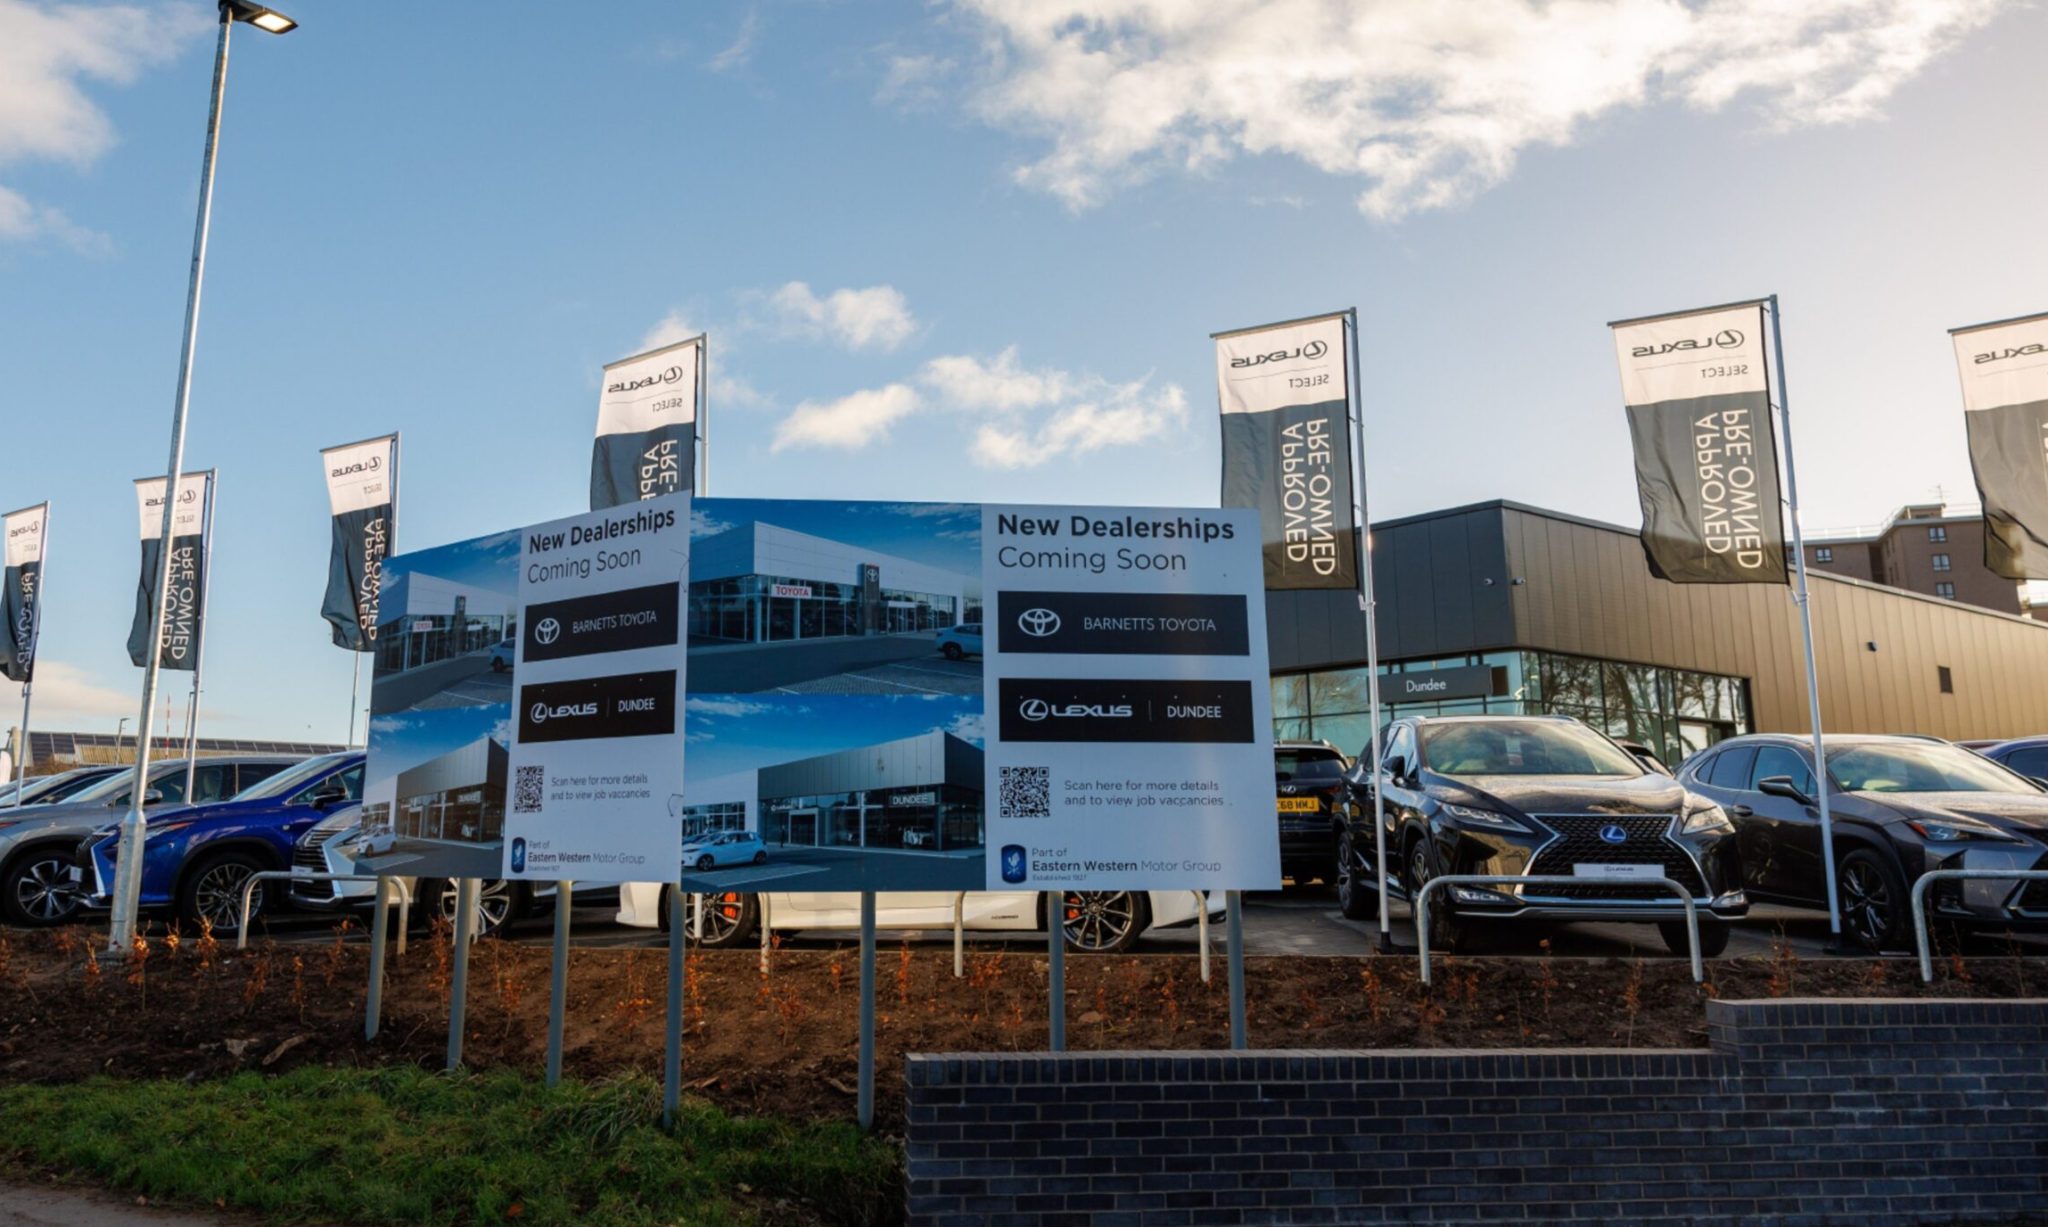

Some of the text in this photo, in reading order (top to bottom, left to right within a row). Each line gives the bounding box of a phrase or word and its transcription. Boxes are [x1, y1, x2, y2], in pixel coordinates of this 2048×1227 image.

[529, 510, 675, 554] New Dealerships
[998, 514, 1235, 543] New Dealerships
[998, 546, 1187, 573] Coming Soon
[528, 549, 640, 584] Coming Soon
[776, 586, 809, 596] TOYOTA
[573, 611, 657, 634] BARNETTS TOYOTA
[1084, 617, 1216, 632] BARNETTS TOYOTA
[1406, 678, 1447, 693] Dundee
[549, 698, 656, 718] LEXUS DUNDEE
[1051, 705, 1222, 718] LEXUS DUNDEE
[622, 772, 648, 784] details
[1064, 780, 1219, 791] Scan here for more details
[893, 795, 928, 805] DUNDEE
[1064, 795, 1086, 806] and
[1089, 795, 1102, 806] to
[1105, 795, 1133, 806] view
[1137, 795, 1156, 807] job
[528, 852, 645, 865] Eastern Western Motor Group
[1032, 848, 1067, 857] Part of
[1032, 860, 1222, 873] Eastern Western Motor Group
